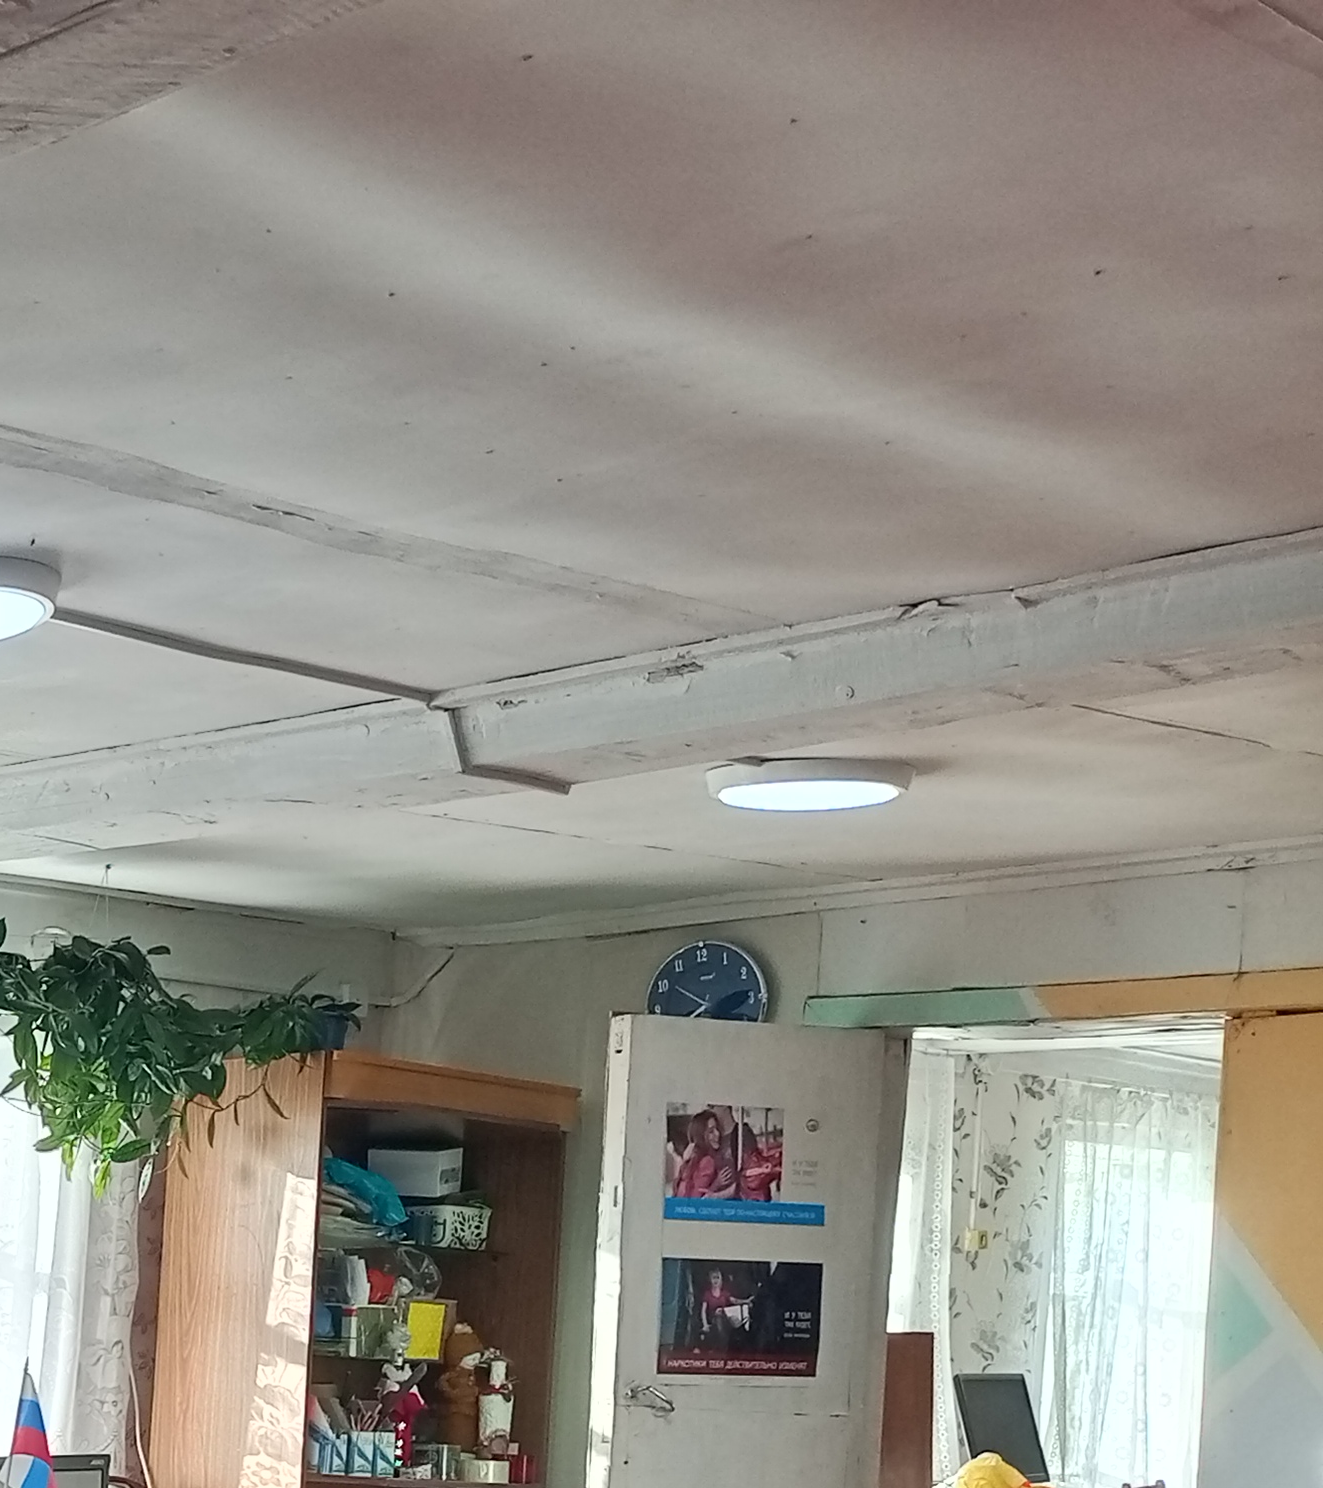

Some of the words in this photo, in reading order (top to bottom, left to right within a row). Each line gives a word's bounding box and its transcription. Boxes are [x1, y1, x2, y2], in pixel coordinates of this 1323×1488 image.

[696, 949, 708, 963] 12
[722, 952, 728, 965] 1
[674, 960, 684, 972] 11
[740, 967, 748, 980] 2
[657, 979, 669, 993] 10
[748, 991, 755, 1004] 3
[667, 1358, 706, 1369] НАРКОТИКИ
[708, 1359, 724, 1369] ТЕБЯ
